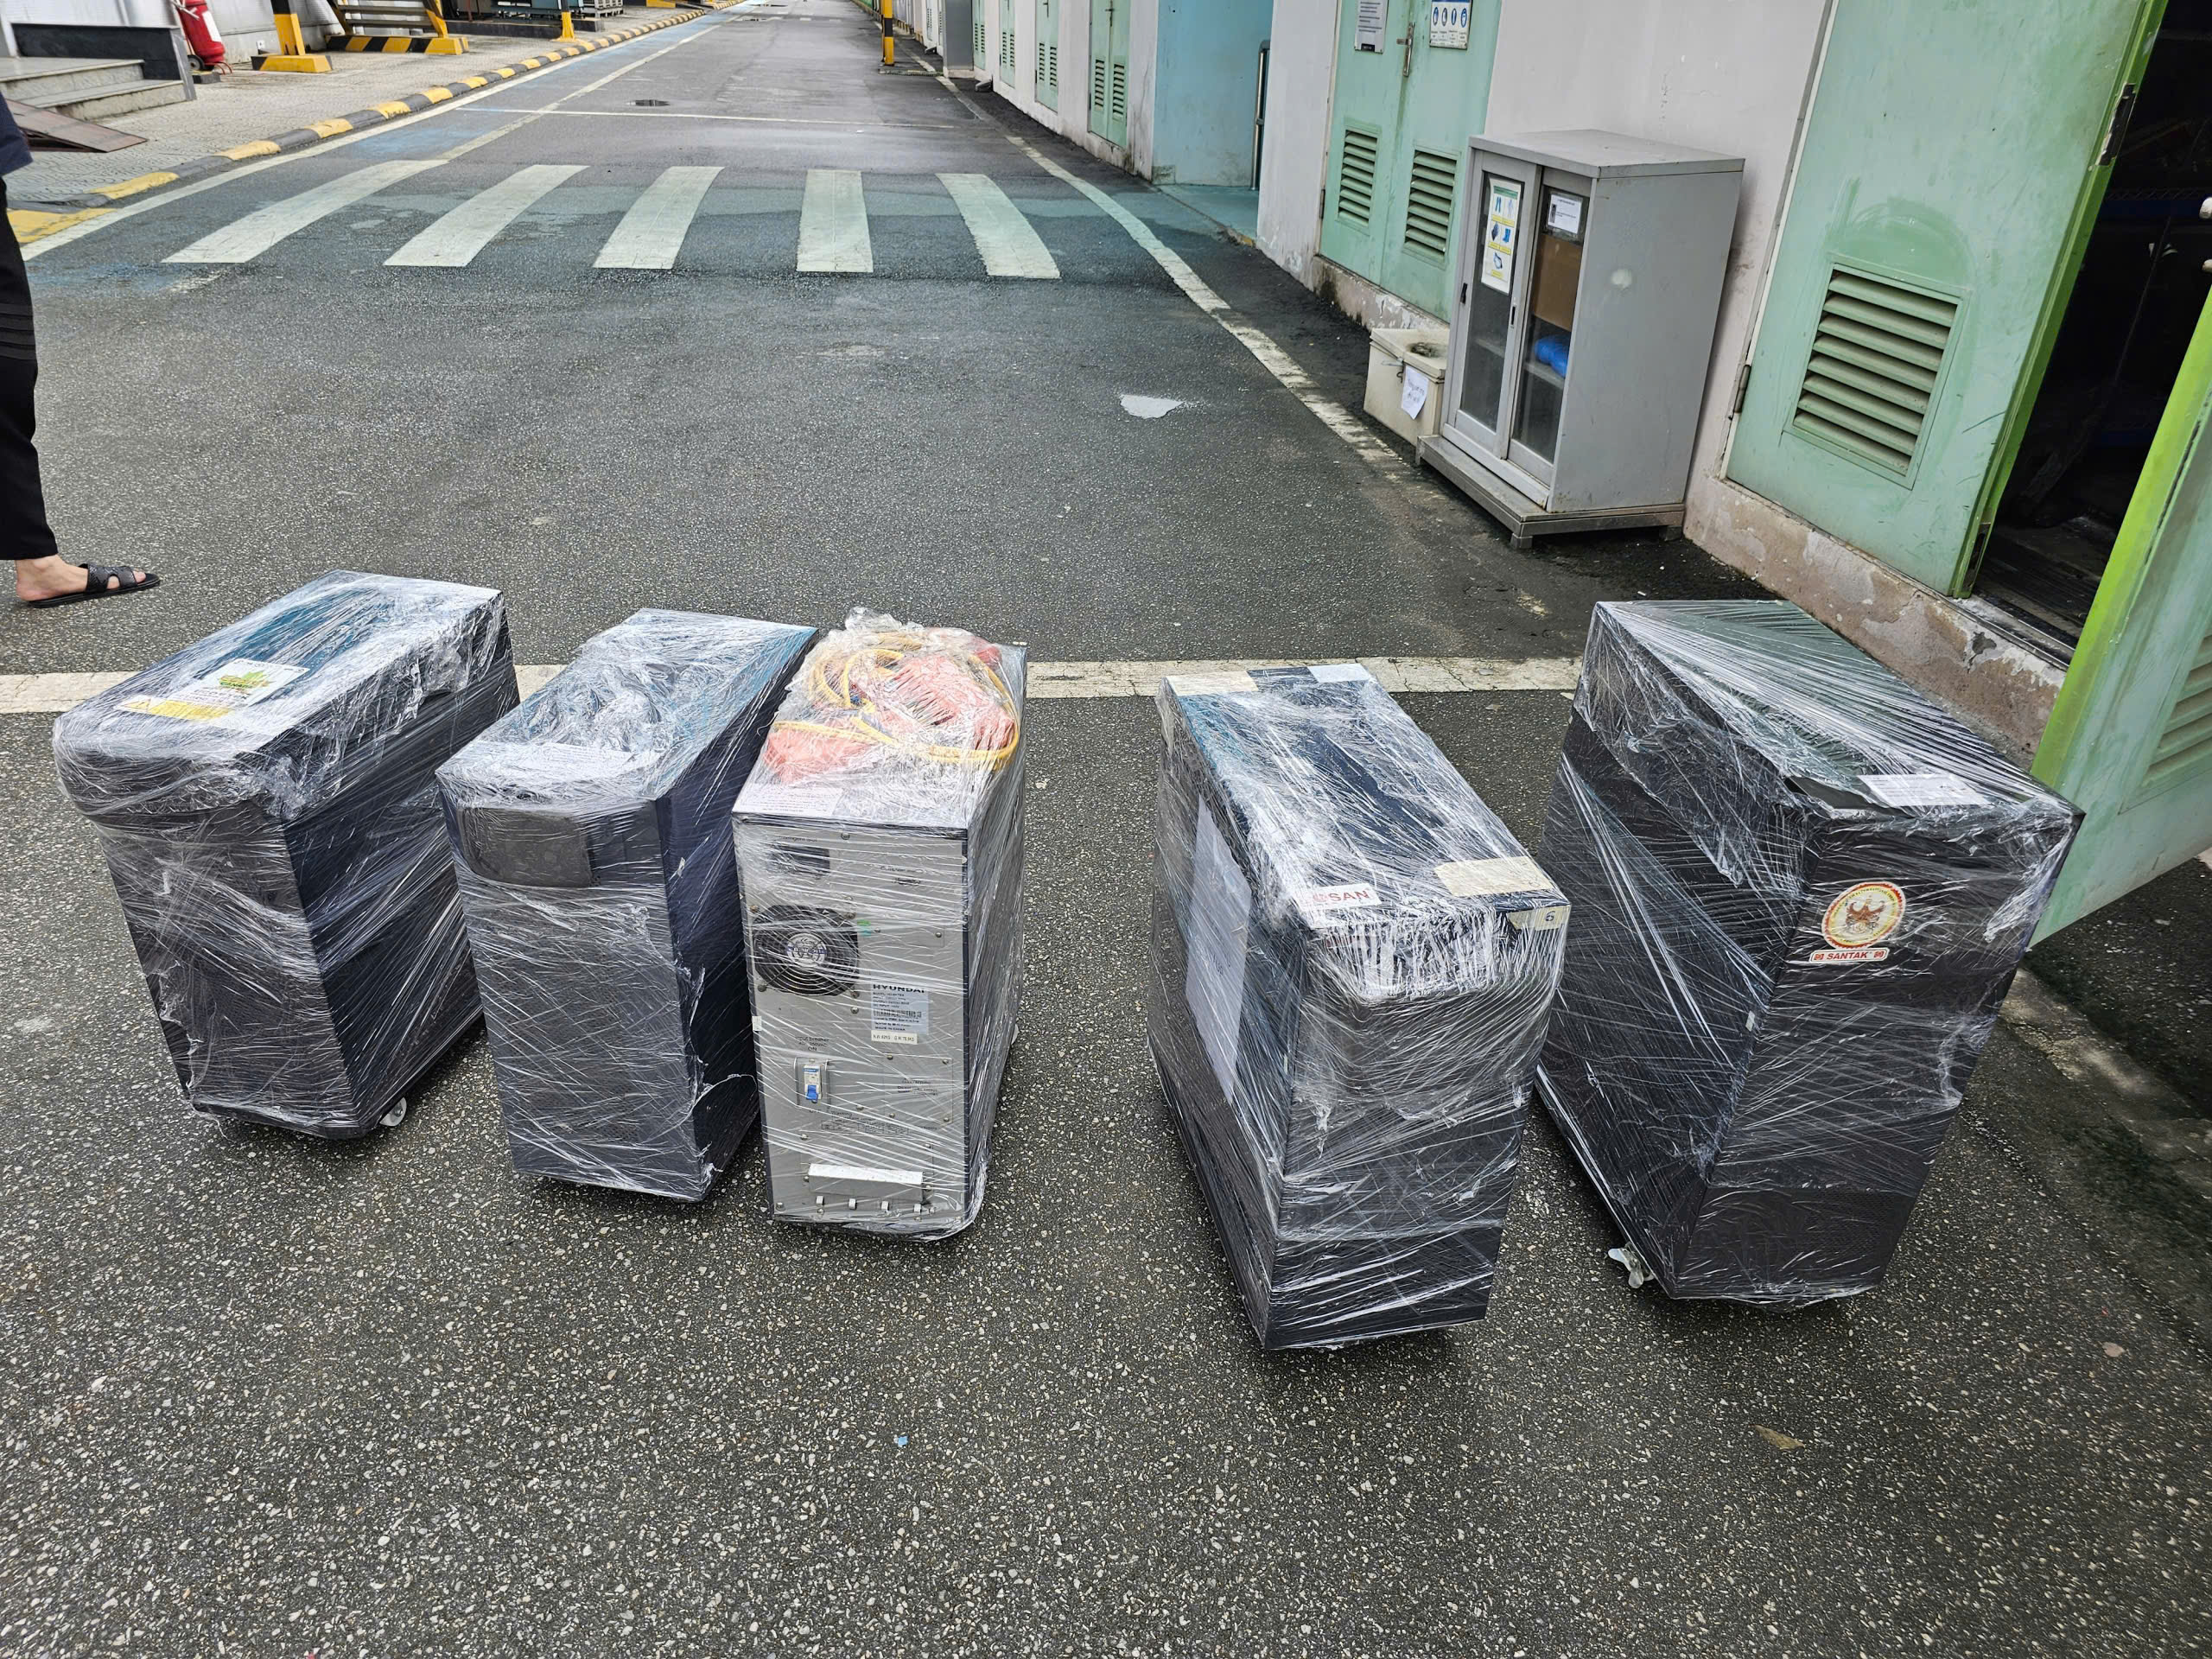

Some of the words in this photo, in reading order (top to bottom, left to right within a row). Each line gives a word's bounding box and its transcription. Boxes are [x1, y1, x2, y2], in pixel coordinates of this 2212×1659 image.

[1545, 910, 1556, 922] 6
[1826, 951, 1868, 960] SANTAK
[873, 984, 925, 994] HYUNDAI
